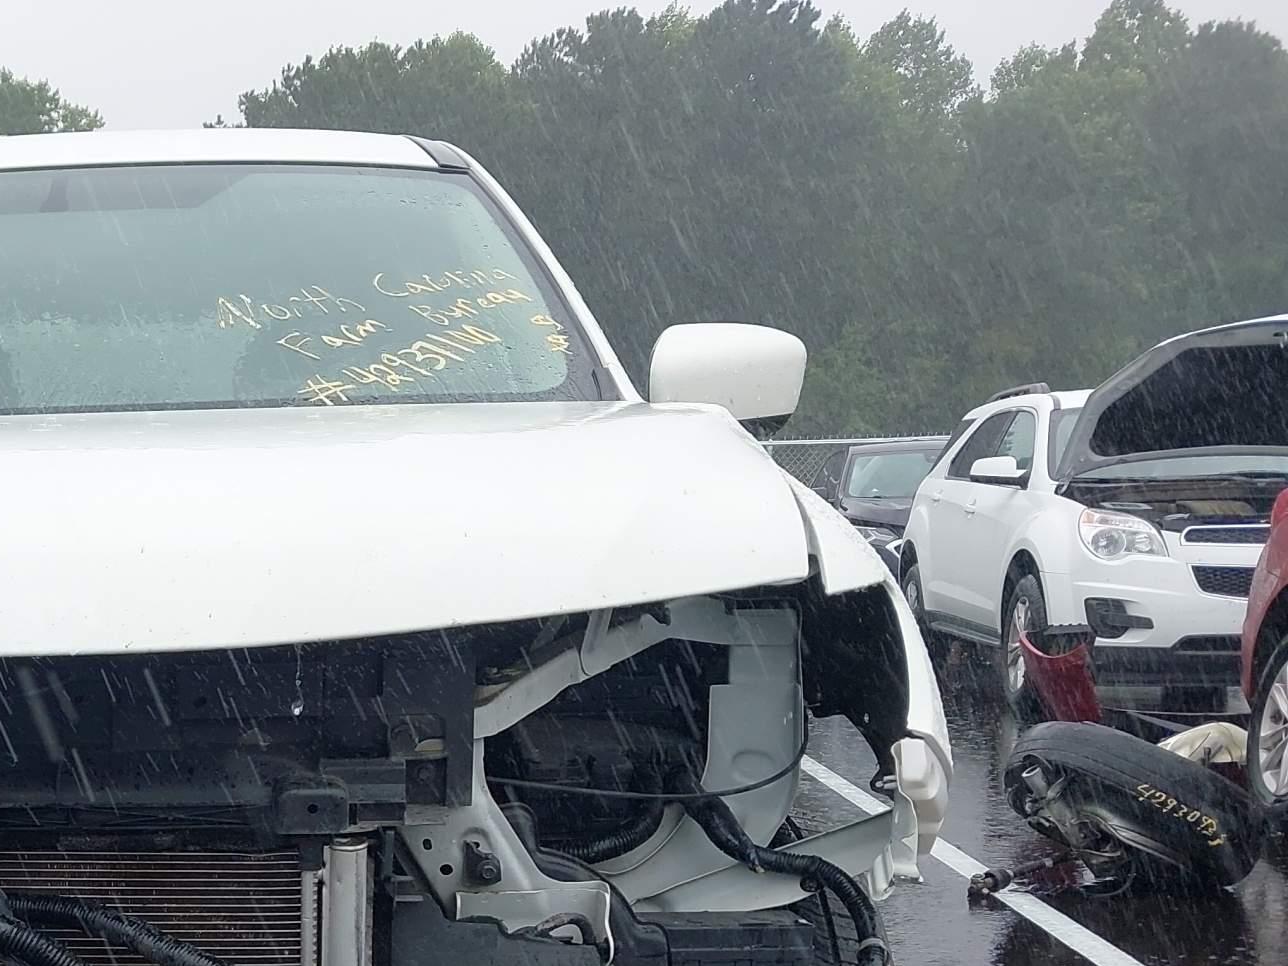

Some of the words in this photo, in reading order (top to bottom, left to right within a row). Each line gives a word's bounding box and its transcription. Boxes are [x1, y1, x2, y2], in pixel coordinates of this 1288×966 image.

[216, 285, 366, 329] North
[276, 319, 387, 360] Farm
[409, 289, 532, 326] Bureau
